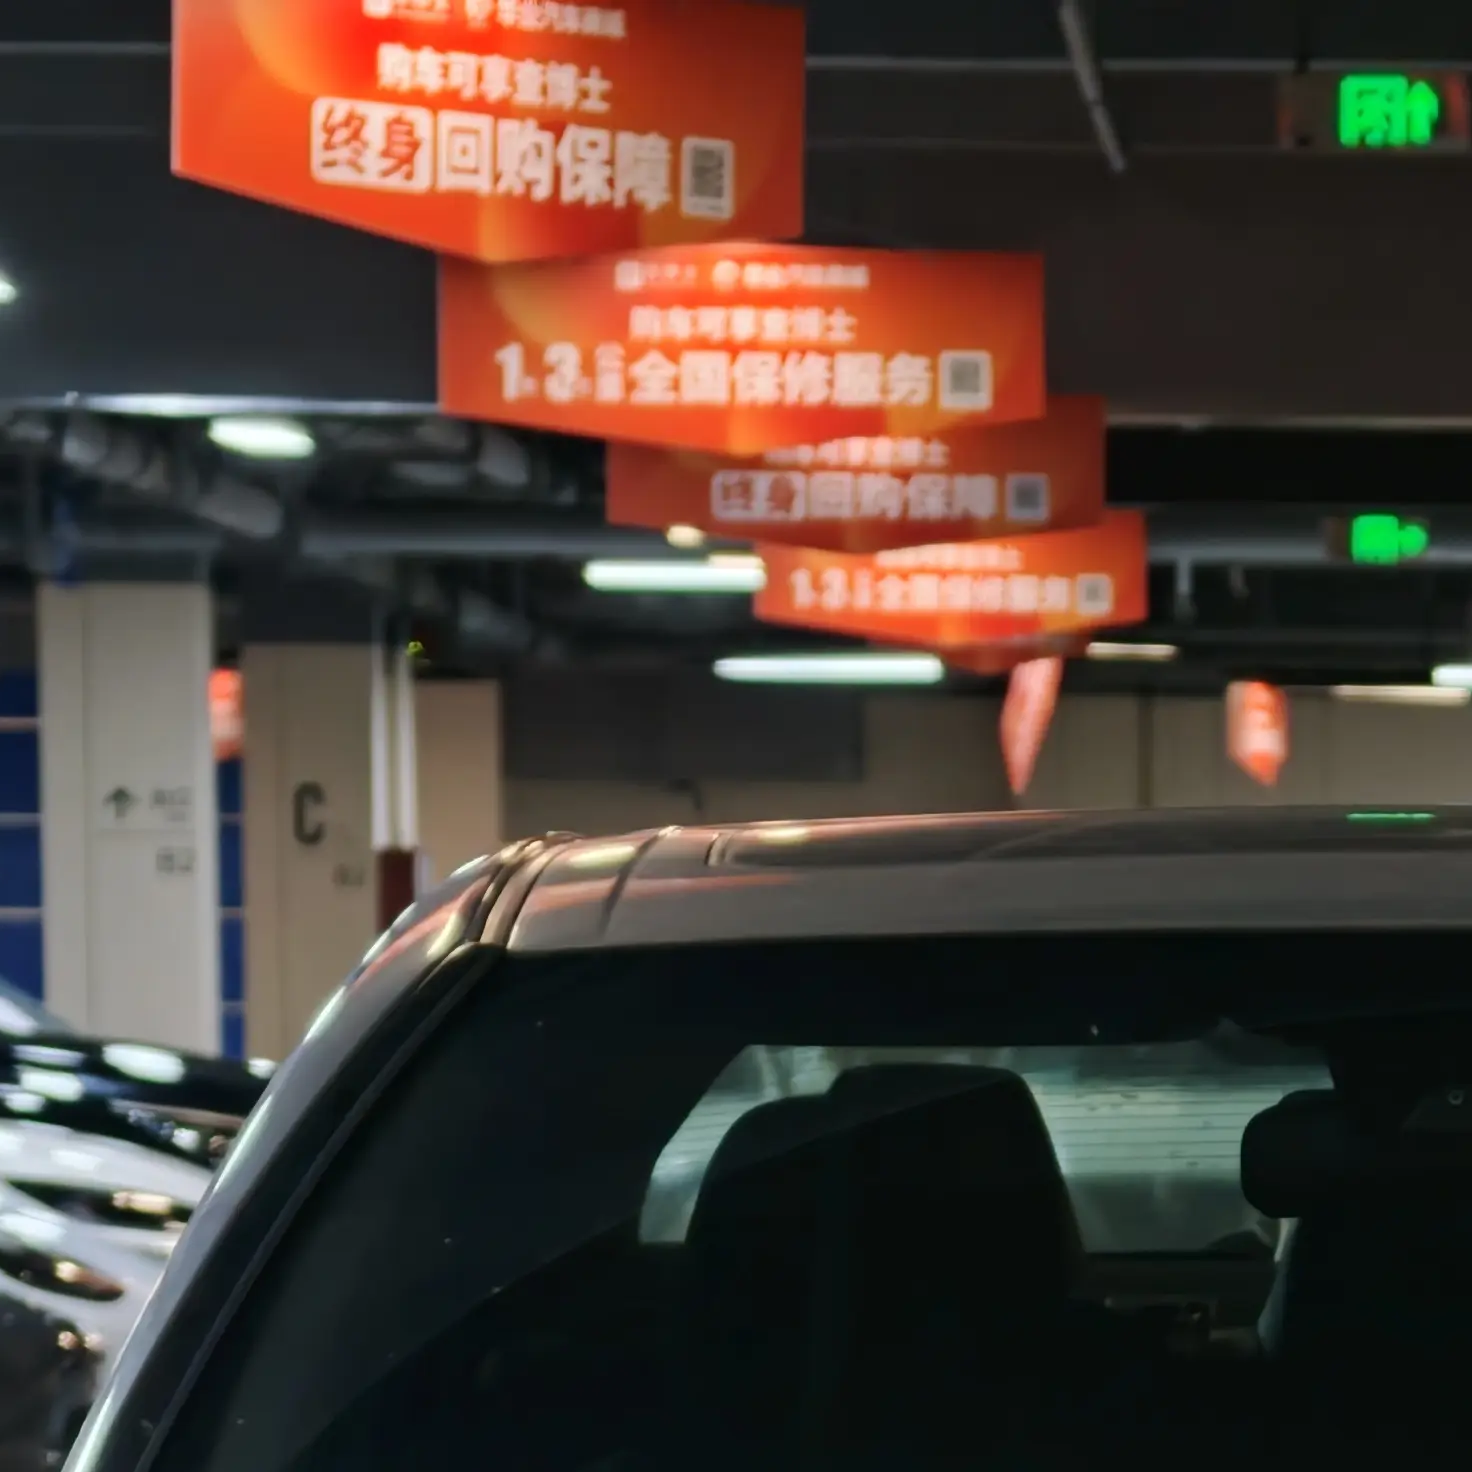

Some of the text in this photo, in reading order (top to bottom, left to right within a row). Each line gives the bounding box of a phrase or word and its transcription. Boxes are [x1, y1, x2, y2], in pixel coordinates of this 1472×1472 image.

[317, 103, 672, 210] 终身回购保障
[293, 781, 326, 846] C
